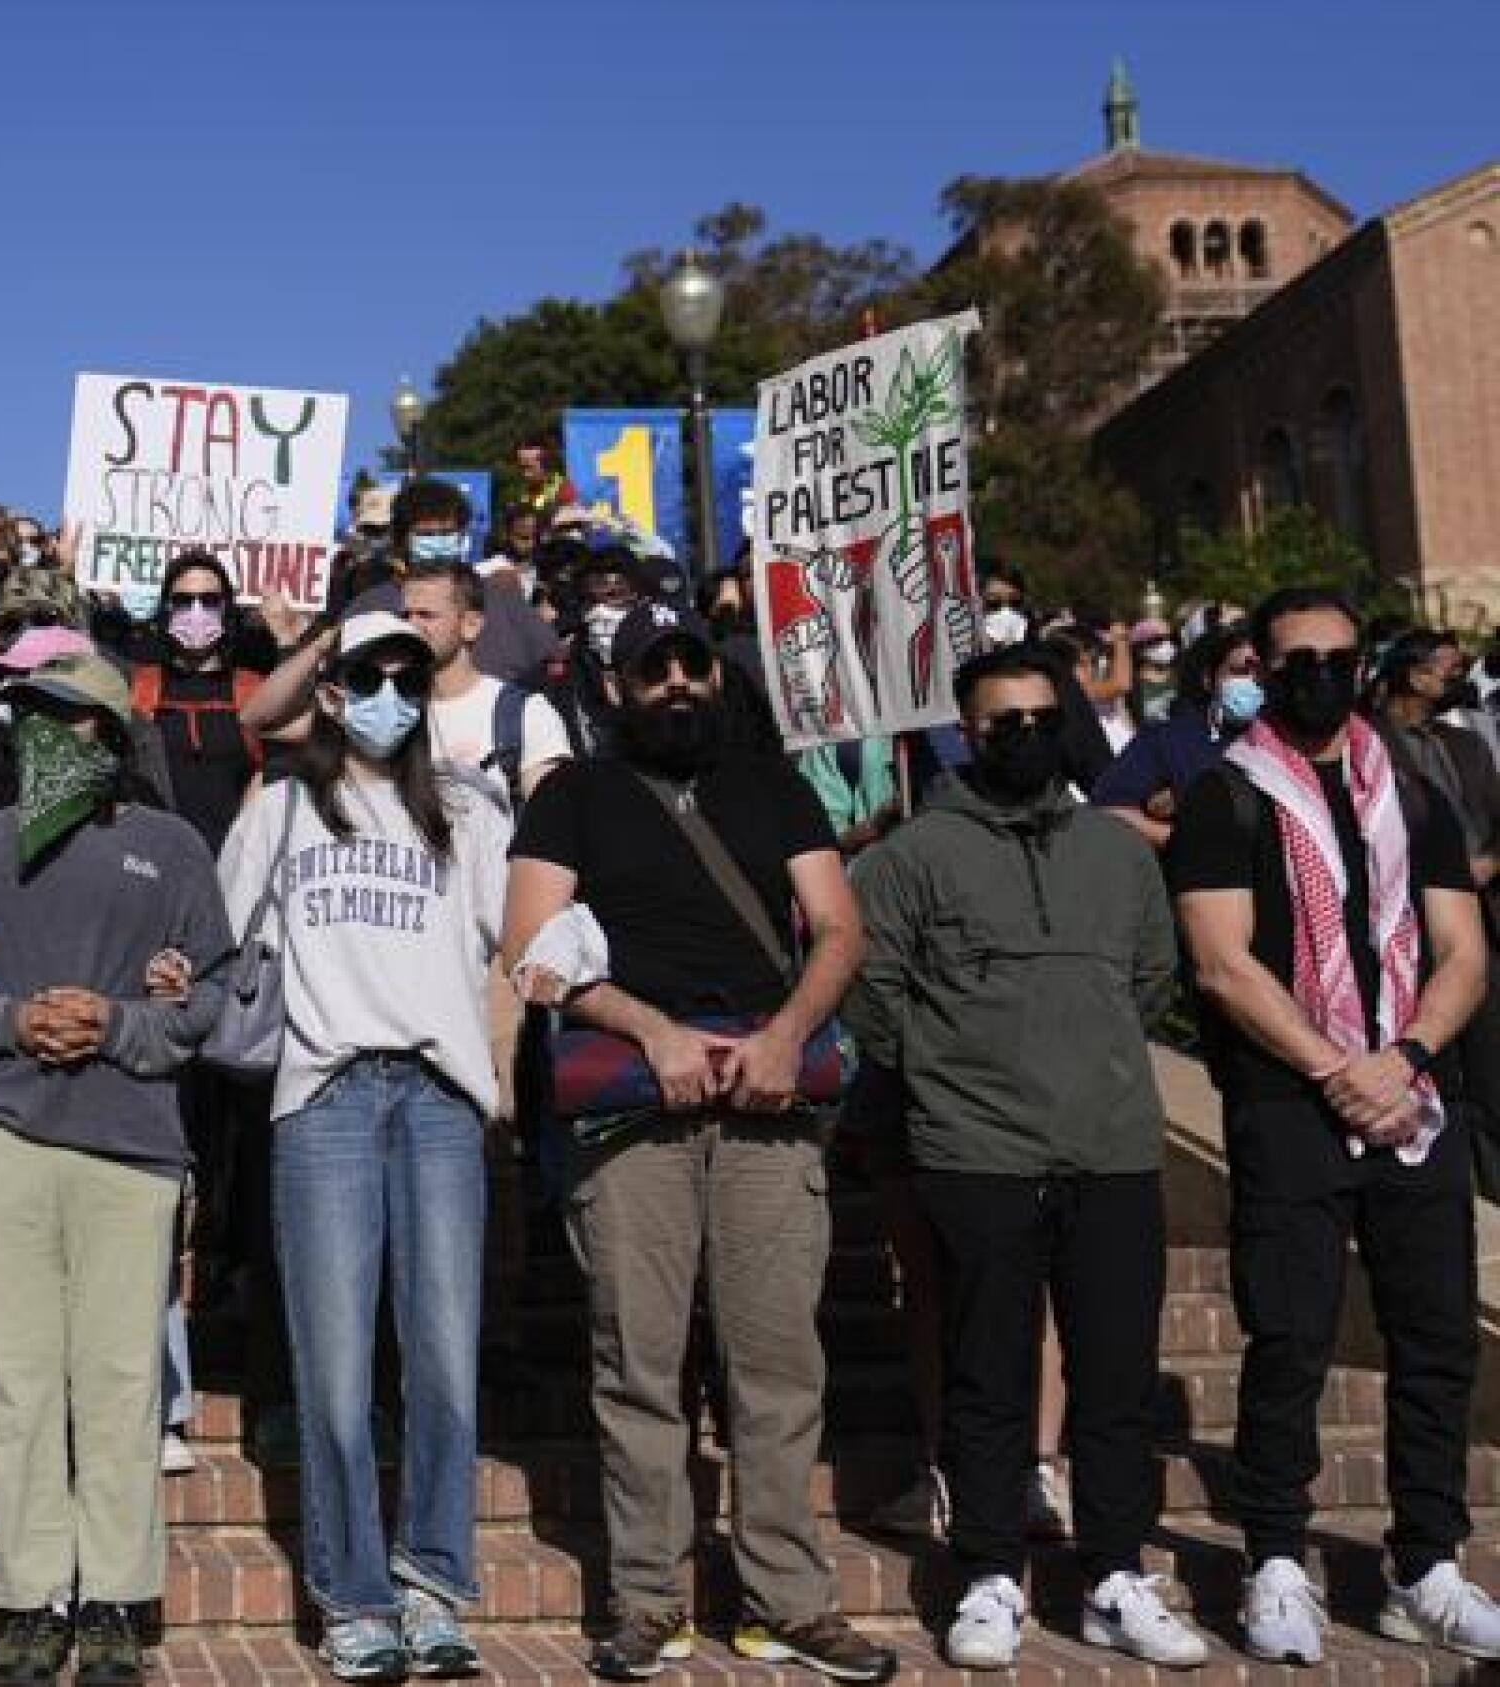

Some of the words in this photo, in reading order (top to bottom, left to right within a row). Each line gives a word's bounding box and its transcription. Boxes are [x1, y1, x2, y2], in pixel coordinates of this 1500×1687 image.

[770, 356, 875, 436] LABOR
[105, 382, 316, 485] STAY
[794, 425, 845, 479] FOR
[98, 468, 280, 541] STRONG
[90, 534, 163, 584] FREE
